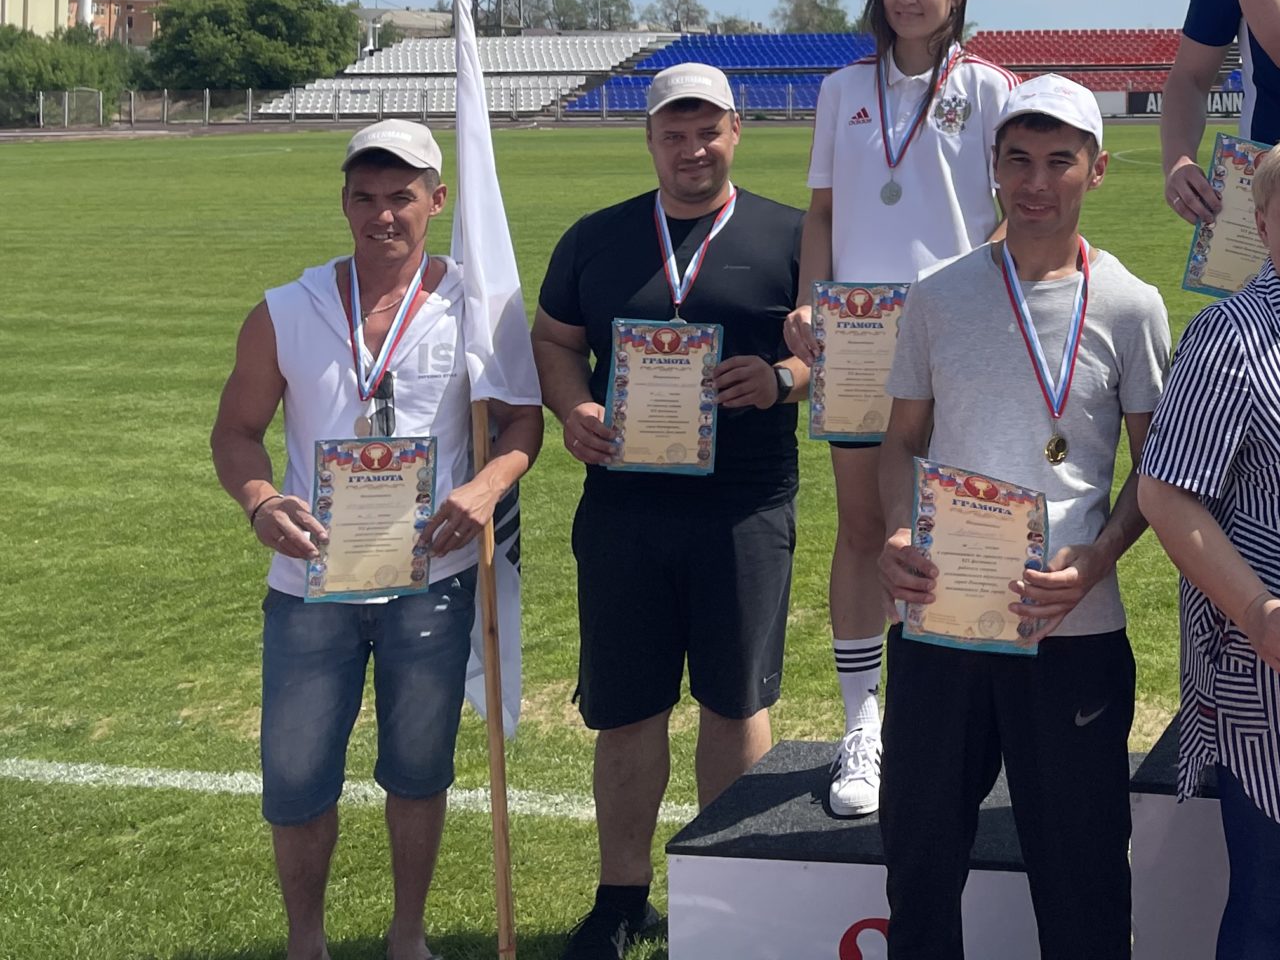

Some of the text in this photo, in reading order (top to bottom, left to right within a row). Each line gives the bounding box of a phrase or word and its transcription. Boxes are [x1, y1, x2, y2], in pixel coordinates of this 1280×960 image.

[836, 321, 884, 329] ГРАМОТА
[418, 342, 455, 374] IS
[641, 357, 691, 365] ГРАМОТА
[348, 474, 404, 483] ГРАМОТА
[951, 498, 1013, 516] ГРАМОТА
